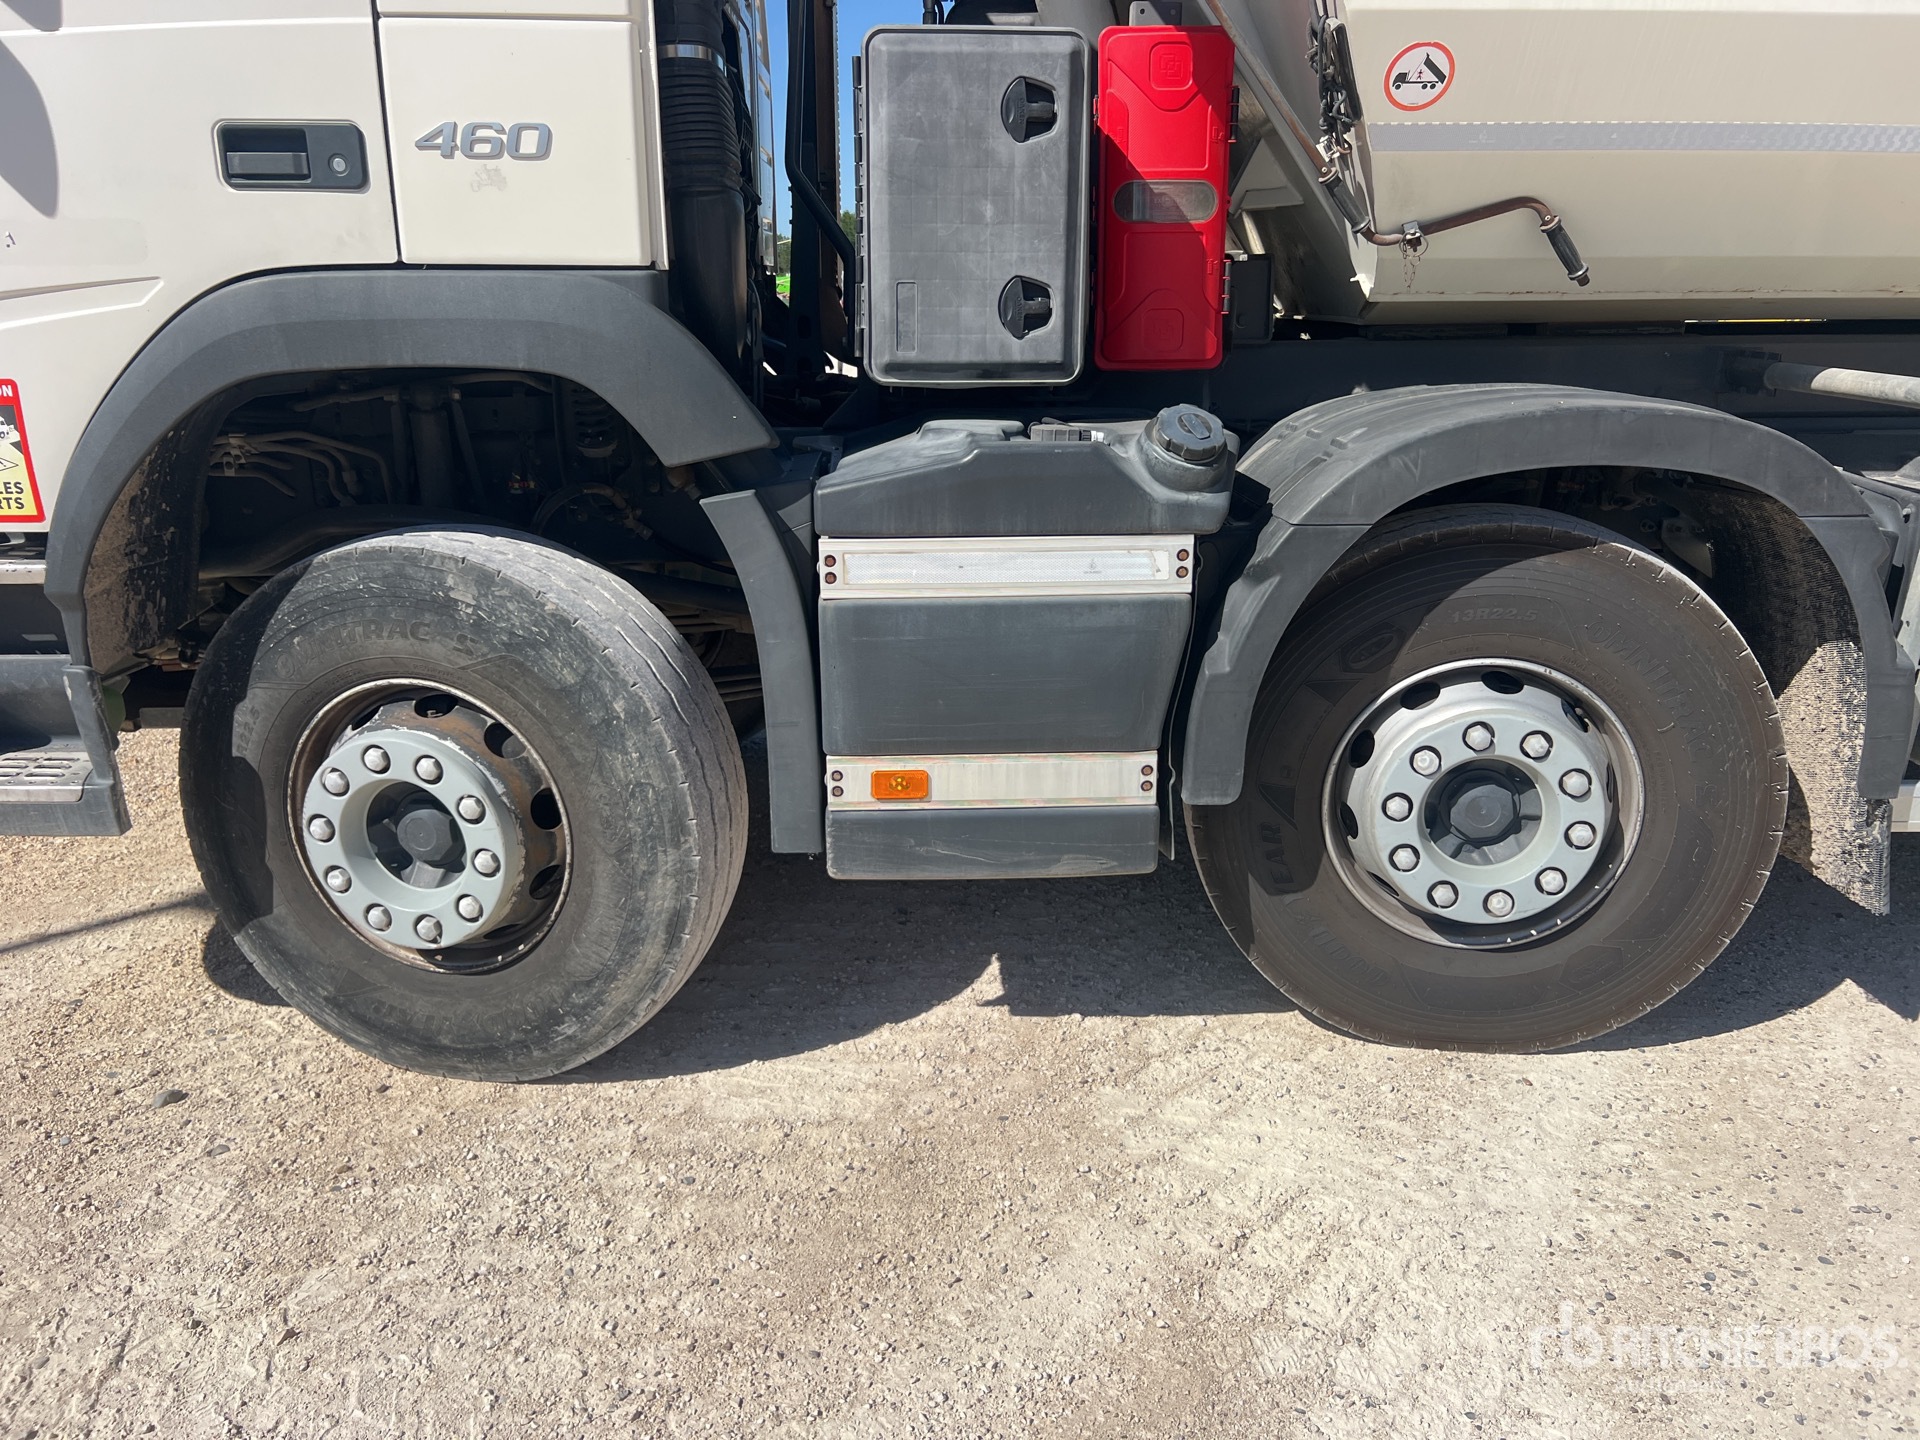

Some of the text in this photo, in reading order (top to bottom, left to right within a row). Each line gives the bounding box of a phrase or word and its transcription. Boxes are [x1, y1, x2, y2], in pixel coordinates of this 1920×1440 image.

[414, 120, 553, 161] 460
[0, 385, 13, 397] N
[1450, 606, 1539, 624] 13R22.5
[275, 616, 432, 680] OMNITRAC
[1585, 620, 1719, 768] OMNITRAC
